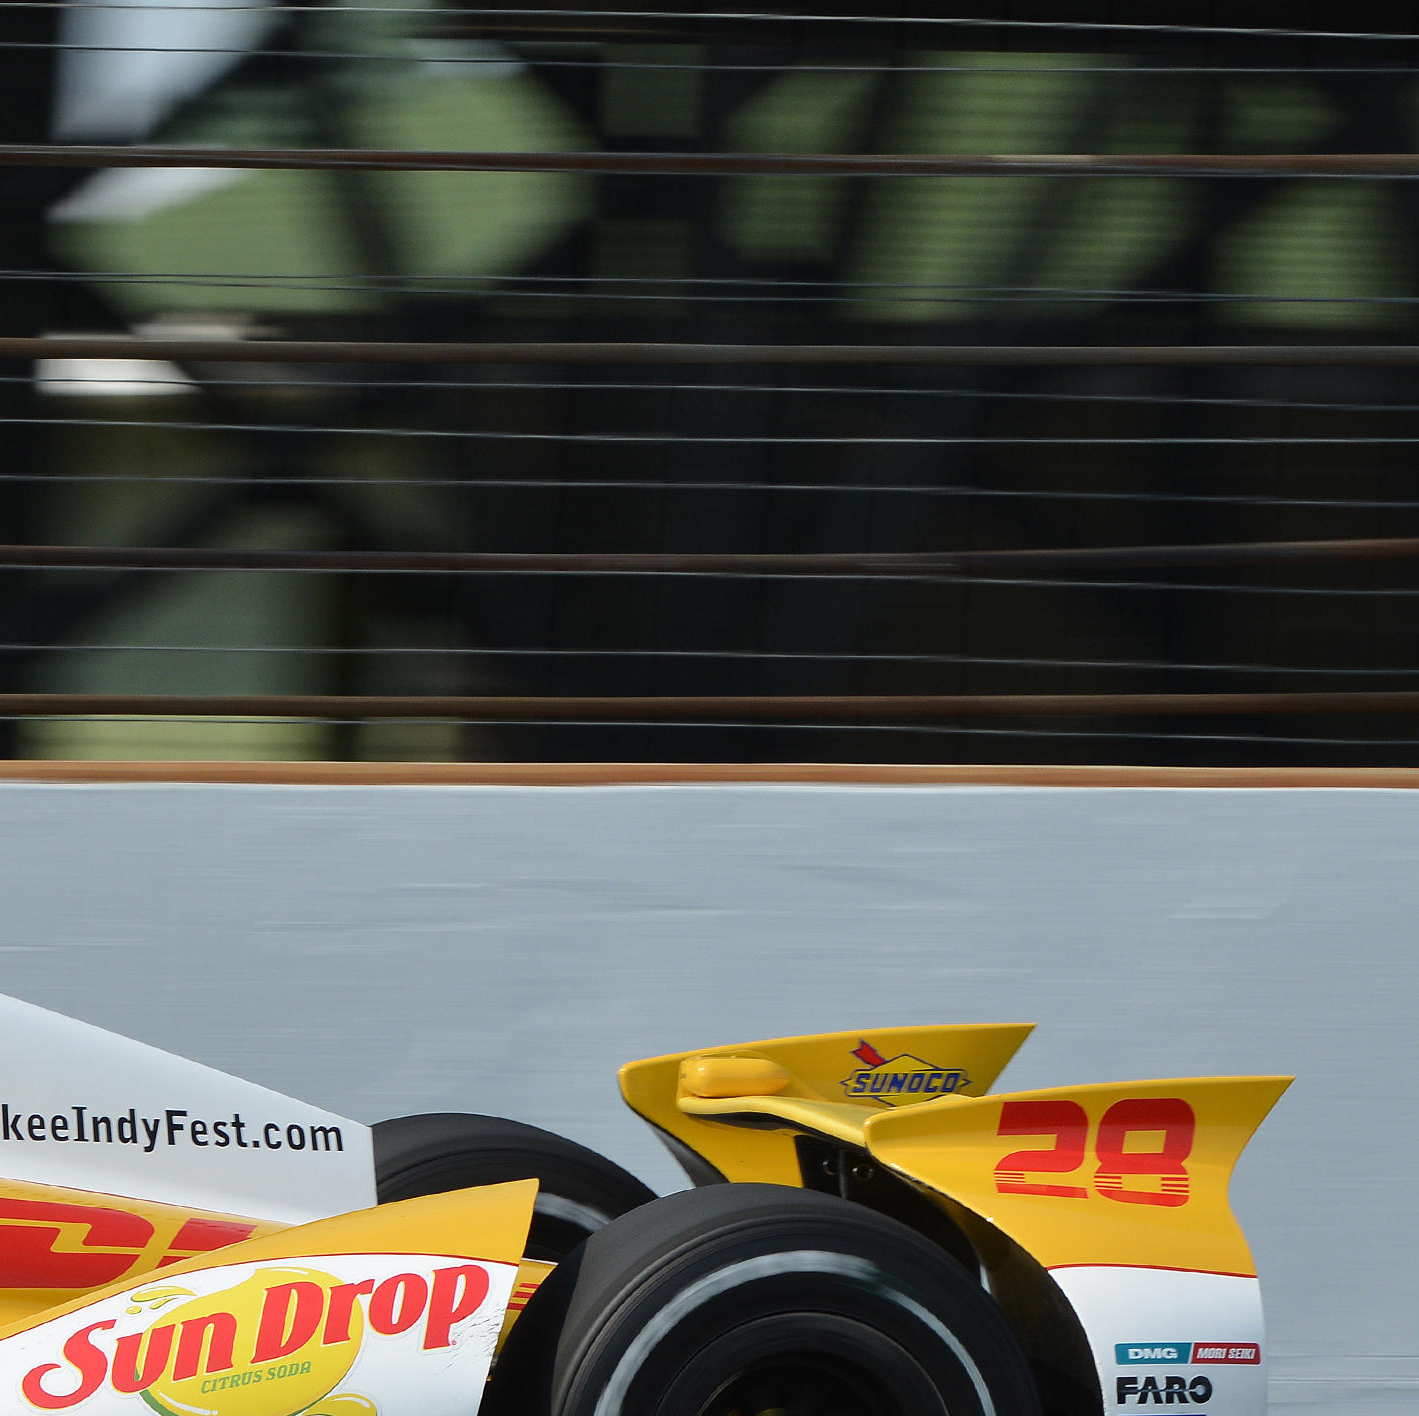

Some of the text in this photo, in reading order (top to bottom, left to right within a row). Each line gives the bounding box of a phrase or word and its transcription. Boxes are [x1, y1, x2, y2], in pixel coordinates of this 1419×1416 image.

[852, 1073, 961, 1093] SUNOCO
[994, 1098, 1196, 1208] 28
[21, 1265, 491, 1411] Sun Drop
[1128, 1348, 1256, 1360] DMG MORI SEIKI
[201, 1360, 312, 1395] CITRUS SODA
[1116, 1376, 1213, 1404] FARO
